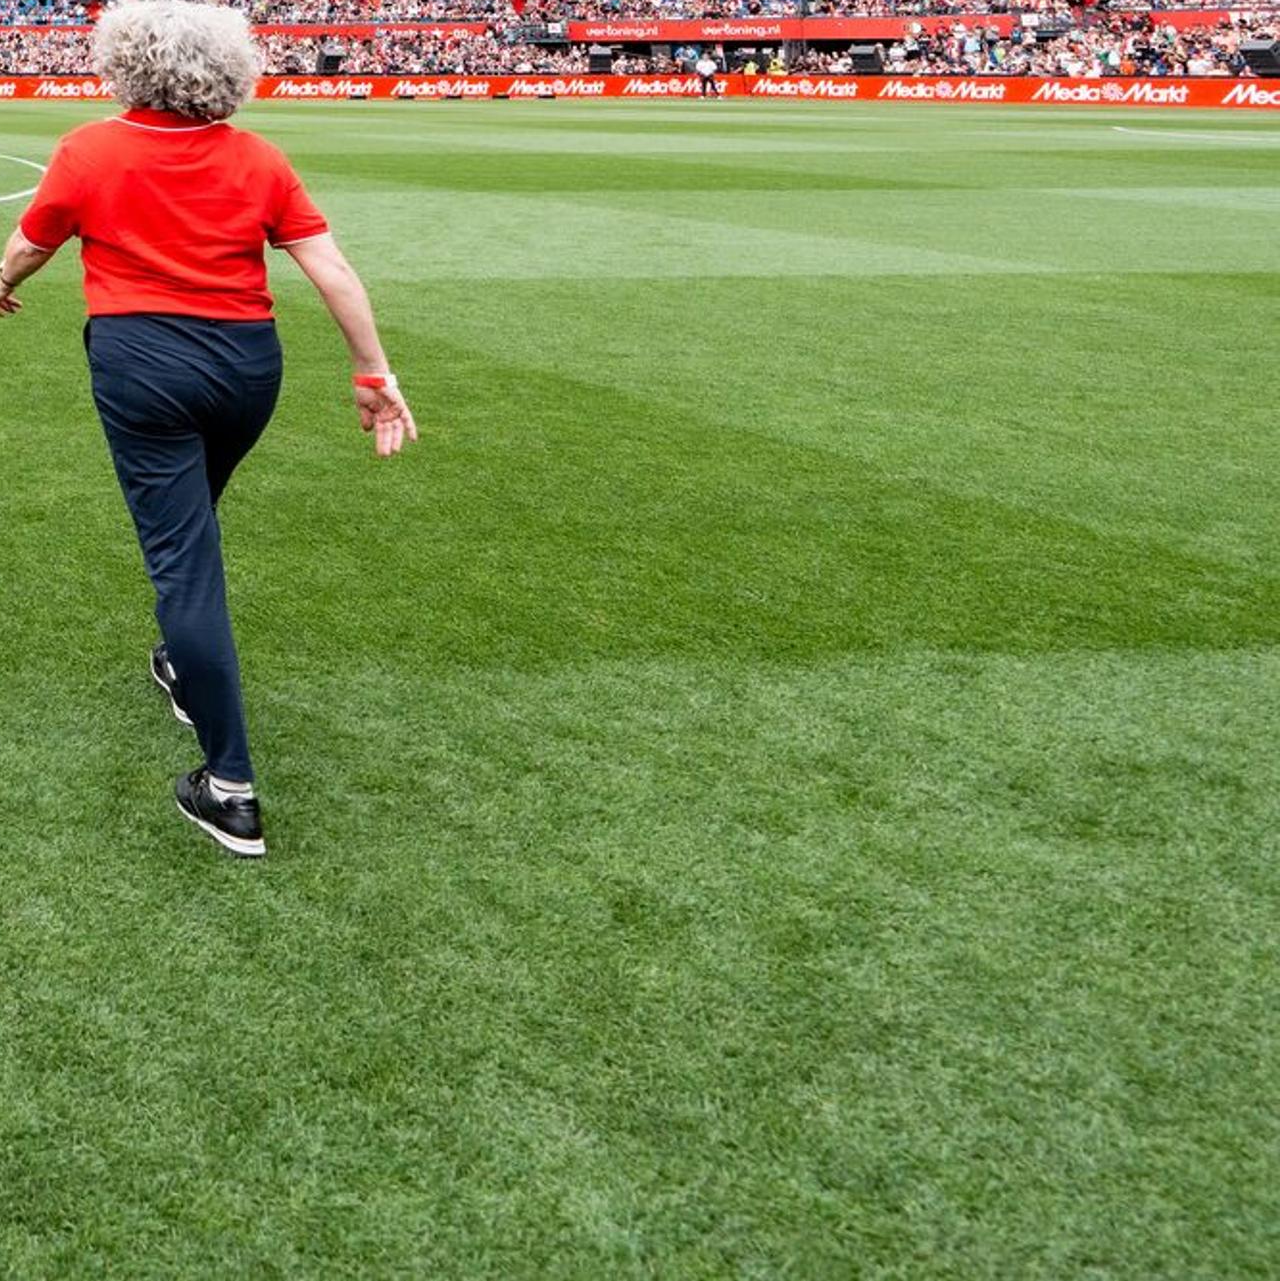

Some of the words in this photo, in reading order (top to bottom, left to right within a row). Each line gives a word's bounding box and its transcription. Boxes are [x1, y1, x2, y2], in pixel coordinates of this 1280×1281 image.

[34, 80, 81, 96] Media
[272, 80, 322, 96] Media
[331, 80, 373, 95] Markt
[391, 80, 438, 96] Media
[448, 80, 490, 95] Markt
[507, 79, 554, 95] Media
[563, 79, 606, 94] Markt
[623, 78, 669, 94] Media
[752, 78, 799, 95] Media
[813, 79, 858, 96] Markt
[879, 80, 933, 98] Media
[950, 81, 1006, 99] Markt
[1031, 81, 1100, 101] Media
[1120, 82, 1189, 103] Markt
